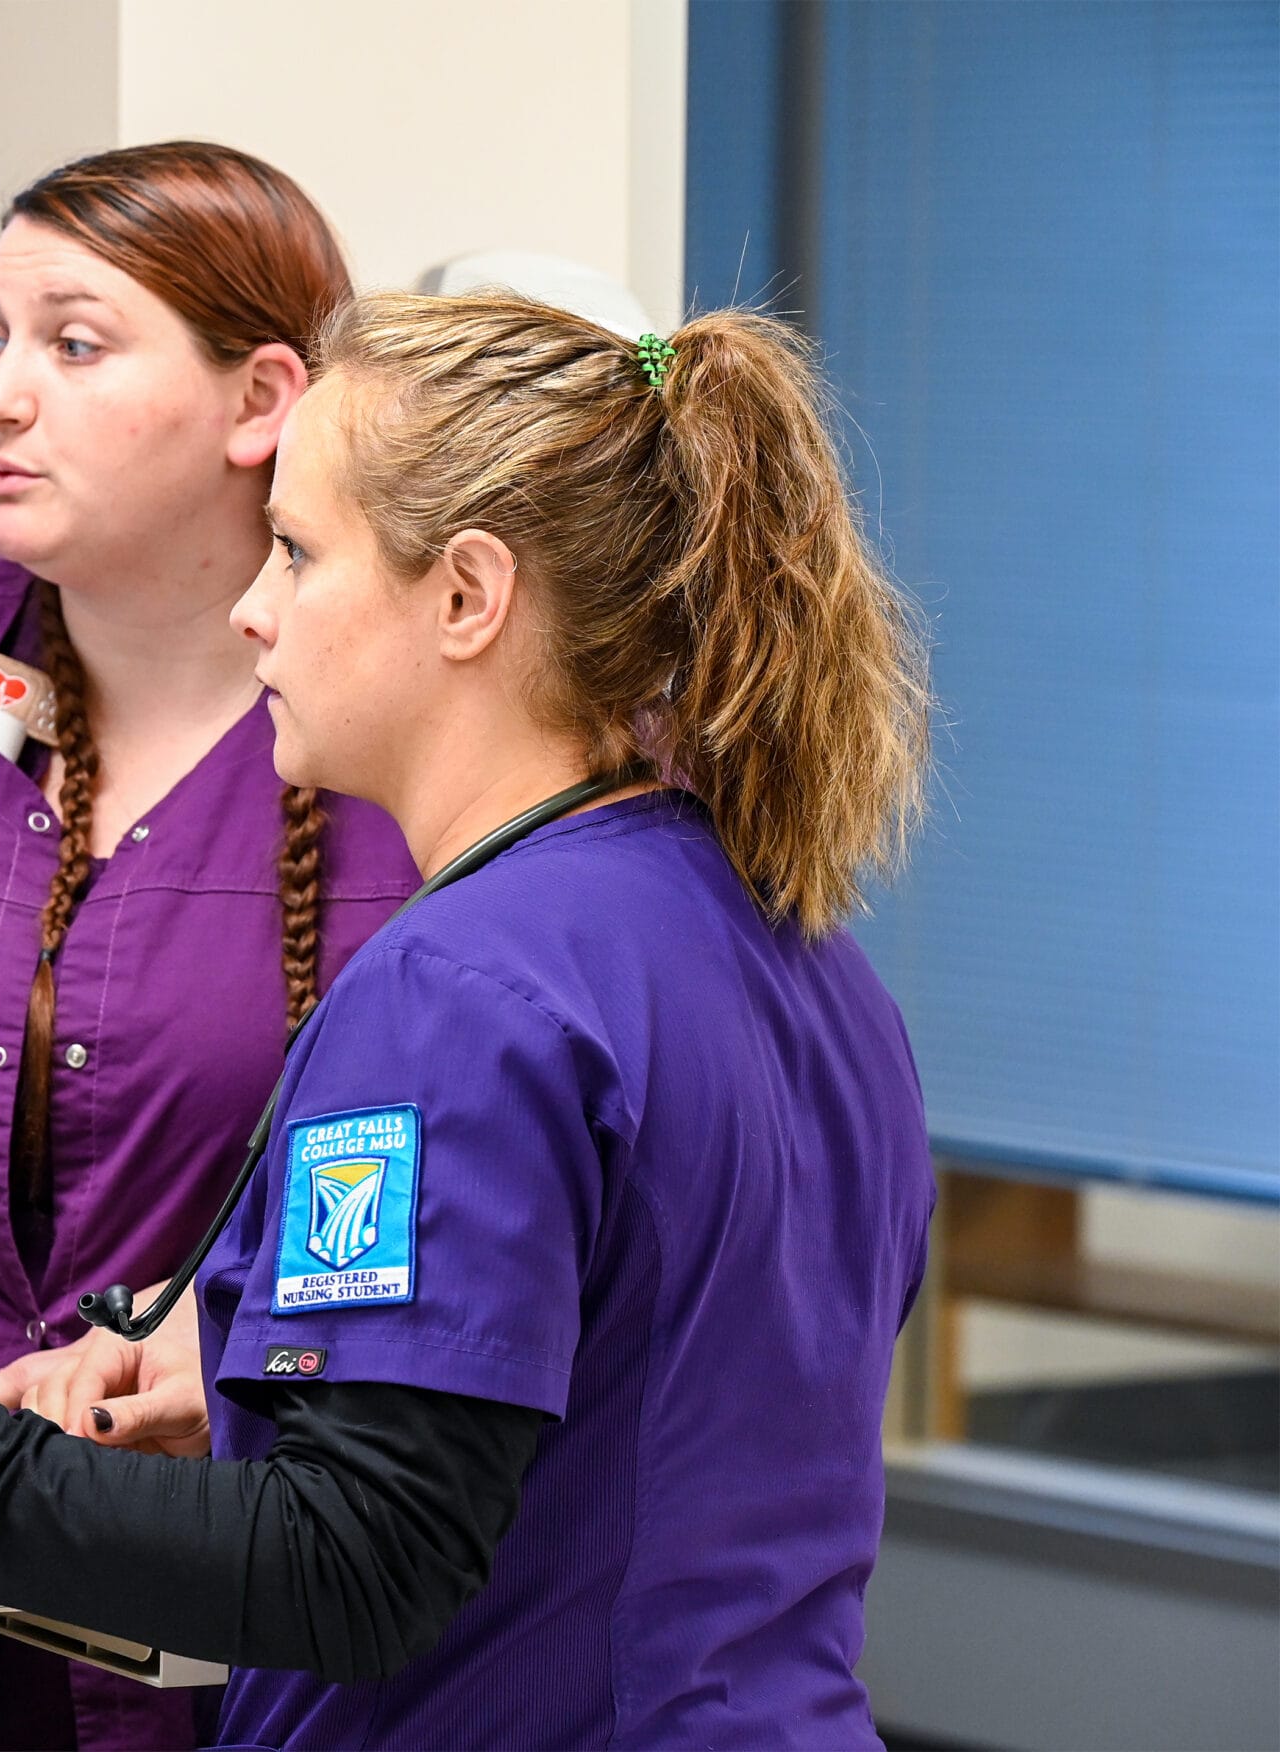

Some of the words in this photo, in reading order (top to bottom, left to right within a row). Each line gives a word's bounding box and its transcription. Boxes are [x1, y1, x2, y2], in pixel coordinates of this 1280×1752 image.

[306, 1121, 352, 1144] GREAT
[357, 1116, 404, 1136] FALLS
[301, 1140, 365, 1162] COLLEGE
[370, 1133, 407, 1151] MSU
[302, 1270, 378, 1289] REGISTERED
[283, 1287, 333, 1305] NURSING
[338, 1283, 401, 1299] STUDENT
[266, 1351, 297, 1373] koi
